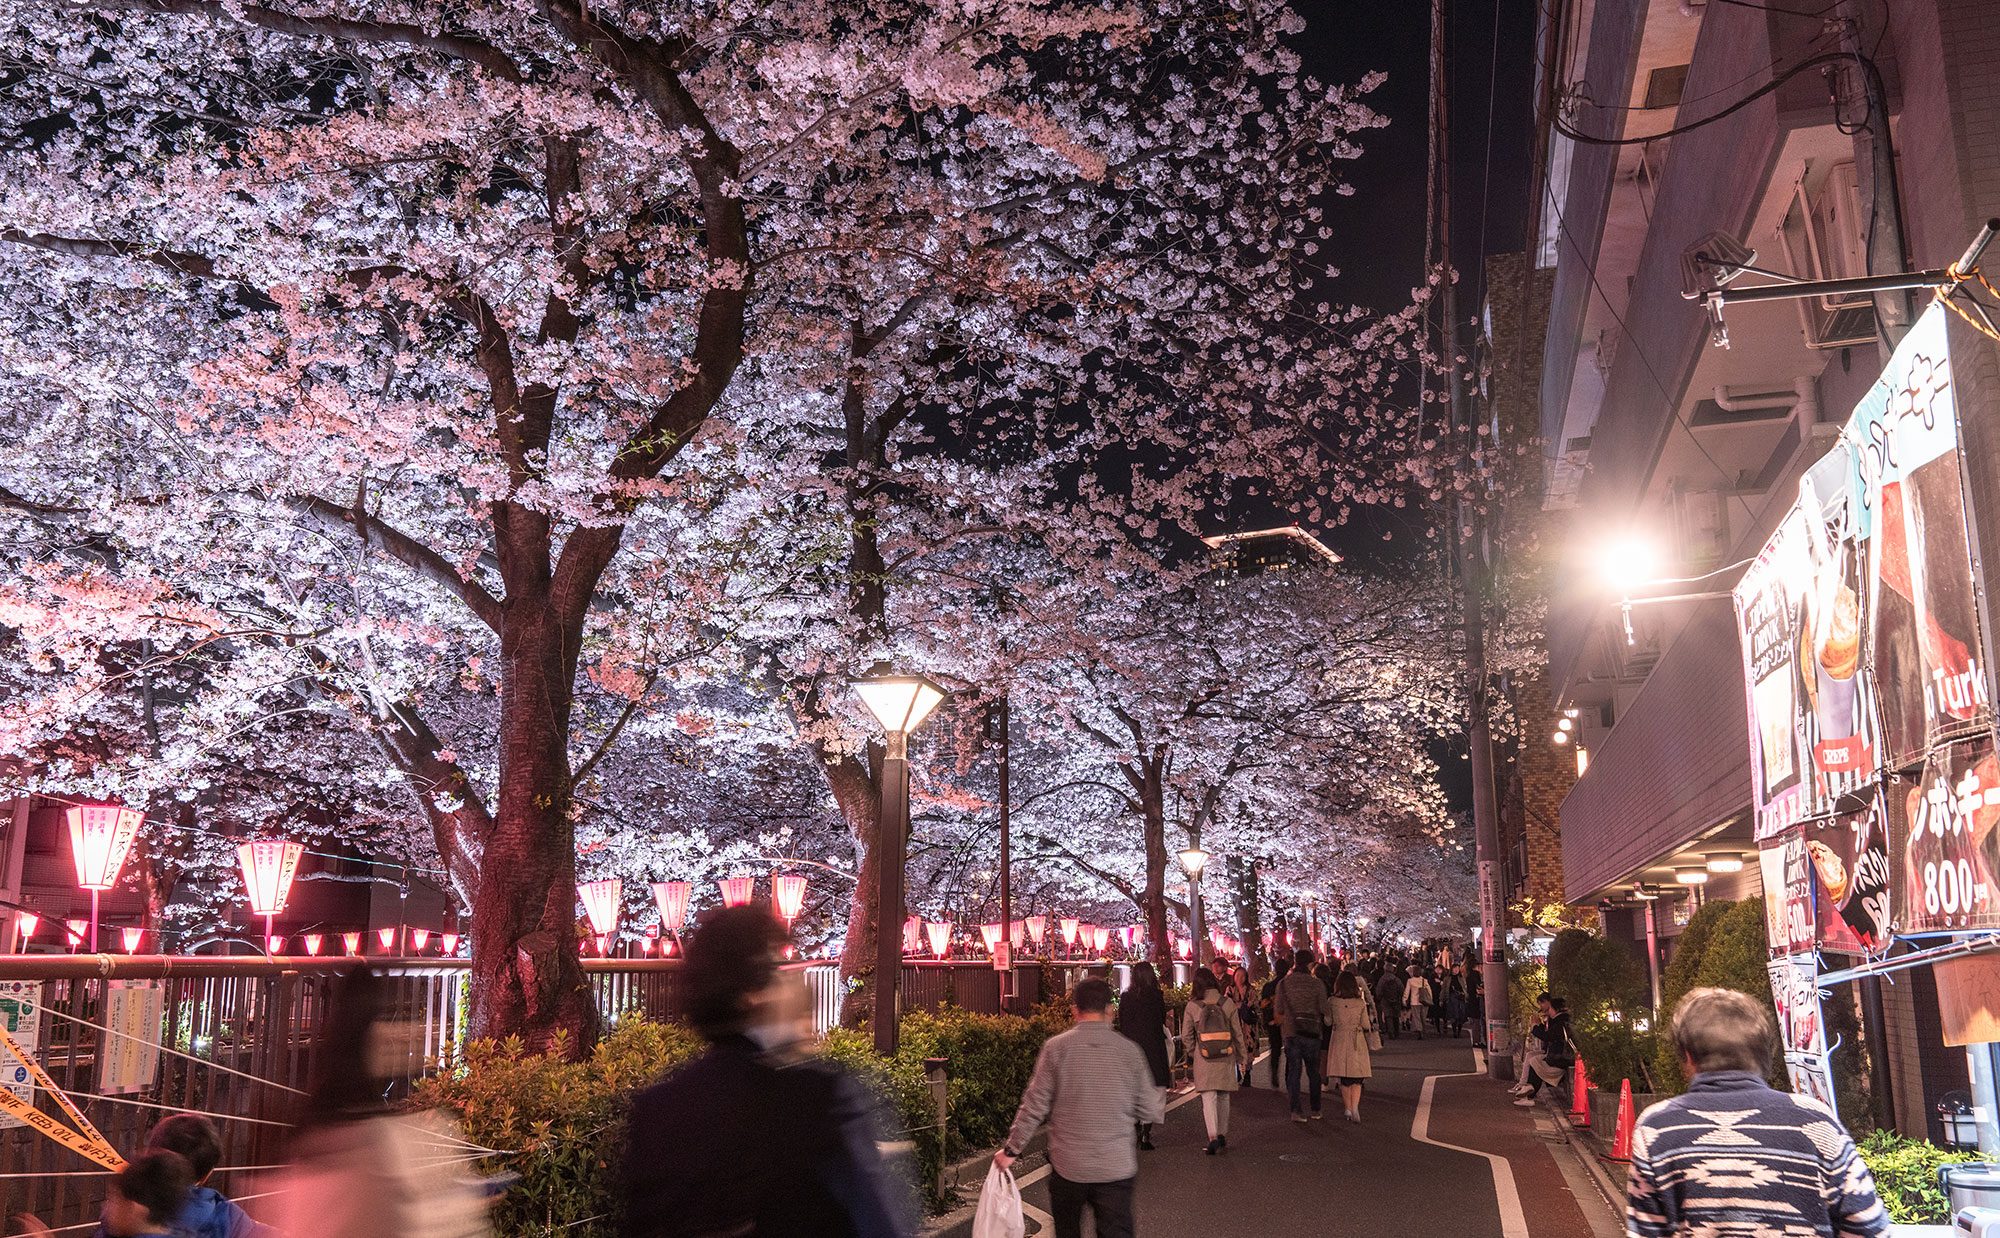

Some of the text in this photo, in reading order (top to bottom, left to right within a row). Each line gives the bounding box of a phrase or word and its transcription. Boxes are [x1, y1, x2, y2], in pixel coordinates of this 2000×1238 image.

[1932, 658, 1988, 713] Turk
[1822, 747, 1849, 765] CREPE
[1924, 858, 1973, 915] 800
